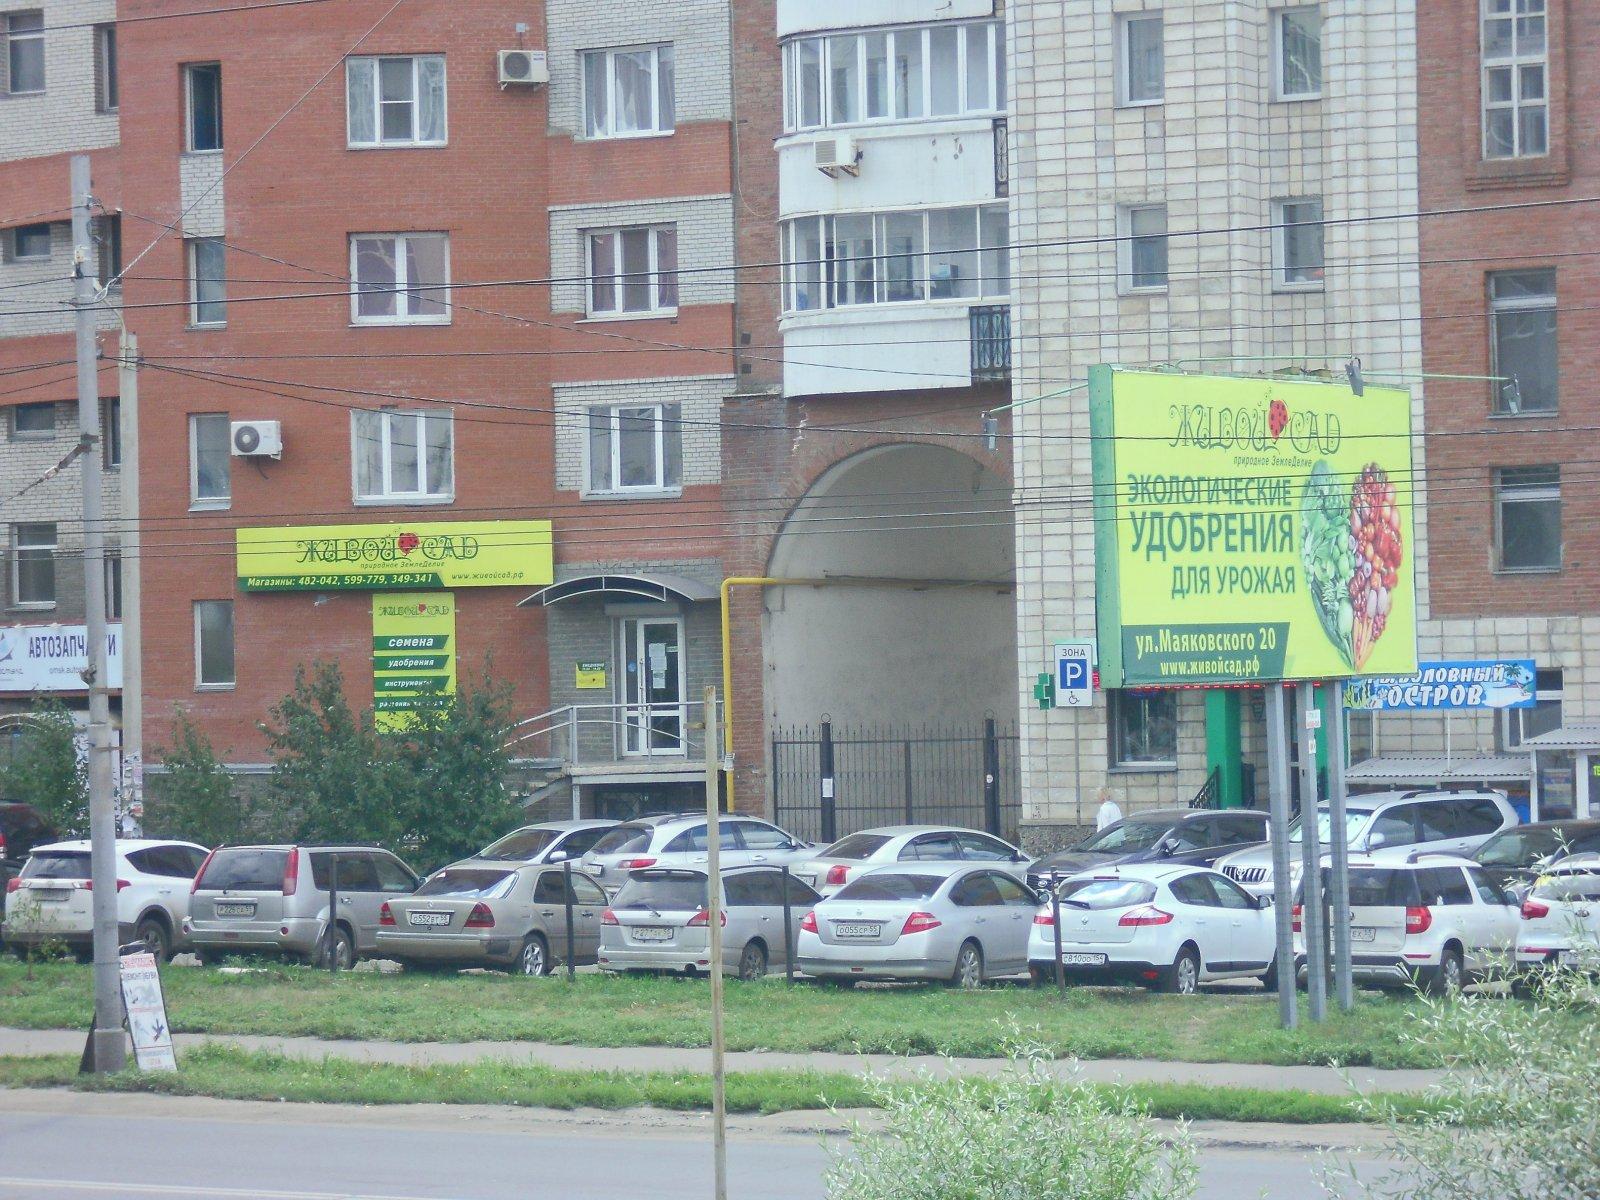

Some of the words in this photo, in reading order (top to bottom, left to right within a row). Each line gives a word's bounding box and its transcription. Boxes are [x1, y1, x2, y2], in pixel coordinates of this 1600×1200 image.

[1168, 401, 1279, 453] ЖИВОЙ
[1290, 411, 1341, 455] САД
[1233, 456, 1270, 468] природное
[1127, 474, 1292, 506] ЭКОЛОГИЧЕСКИЕ
[296, 532, 410, 563] ЖИВОЙ
[422, 535, 478, 560] САД
[1130, 511, 1294, 561] УДОБРЕНИЯ
[360, 562, 398, 570] природное
[451, 571, 524, 580] www.живойсад.рф
[247, 577, 295, 587] Магазины:
[299, 575, 340, 586] 482-042,
[344, 575, 388, 585] 599-779,
[391, 573, 433, 584] 349-341
[1171, 566, 1210, 599] ДЛЯ
[1216, 566, 1296, 594] УРОЖАЯ
[29, 634, 116, 659] АВТОЗАПЧИ
[388, 637, 434, 647] семена
[1062, 648, 1086, 657] ЗОНА
[1135, 628, 1255, 659] ул.Маяковского
[1259, 627, 1276, 650] 20
[388, 659, 434, 668] удобрения
[1066, 662, 1082, 687] P
[1160, 659, 1260, 677] www.живойсад.рф
[1387, 684, 1484, 707] ОСТРОВ
